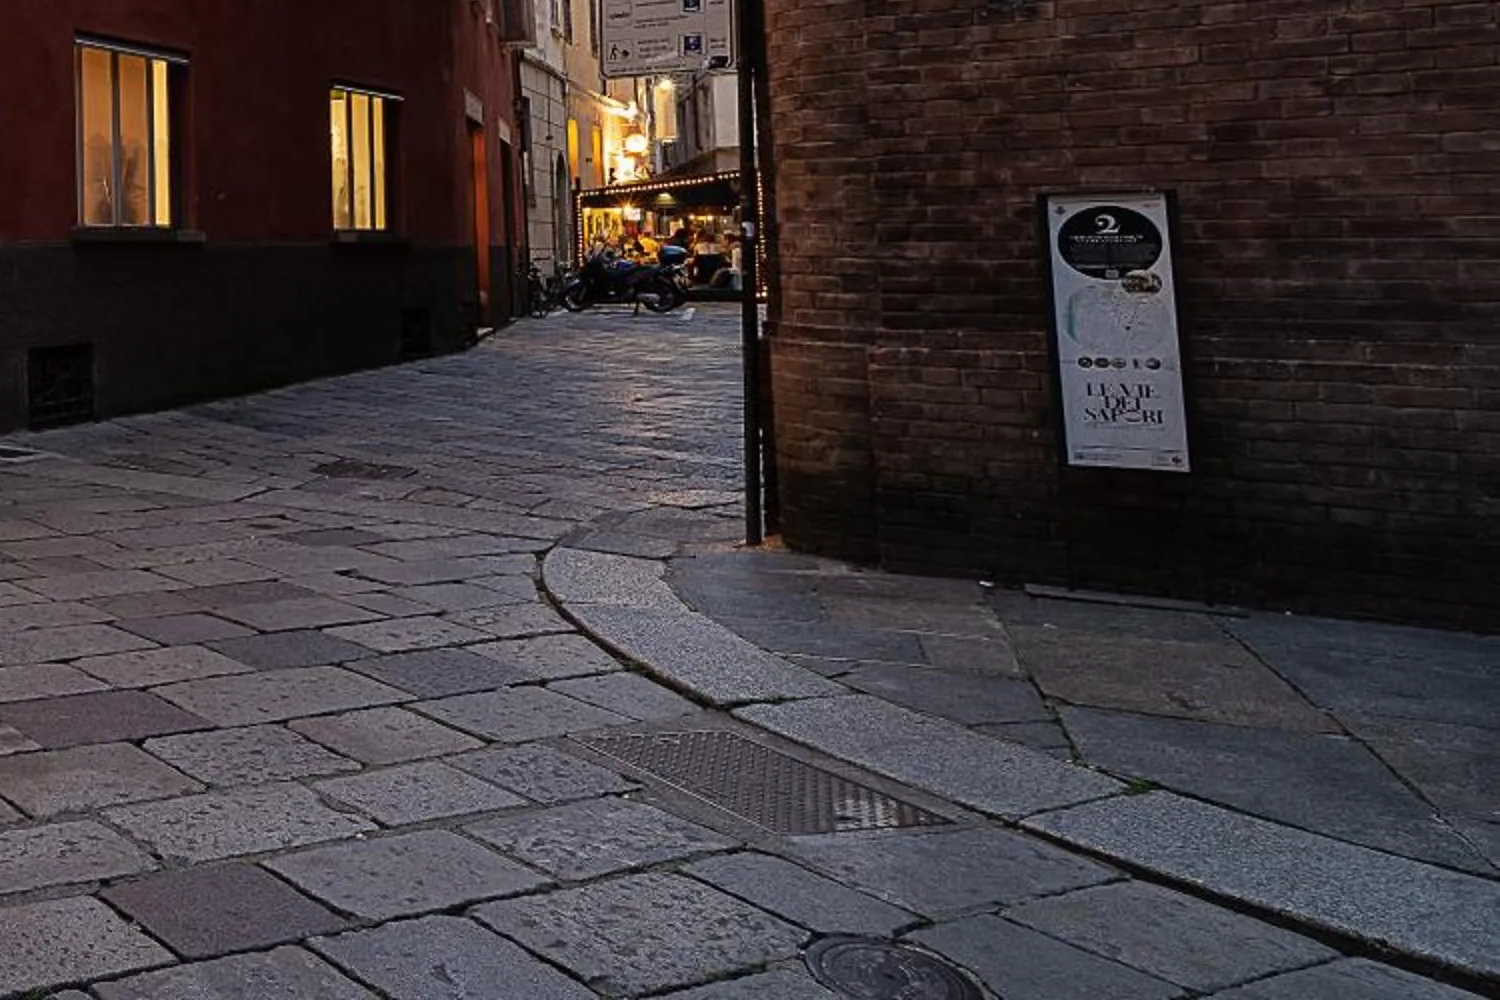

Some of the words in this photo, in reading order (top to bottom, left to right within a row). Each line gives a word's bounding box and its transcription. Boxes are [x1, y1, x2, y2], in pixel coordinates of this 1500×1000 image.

[1095, 213, 1120, 235] 2
[1086, 382, 1115, 398] LE
[1118, 382, 1161, 399] VIE
[1104, 396, 1142, 411] DEI
